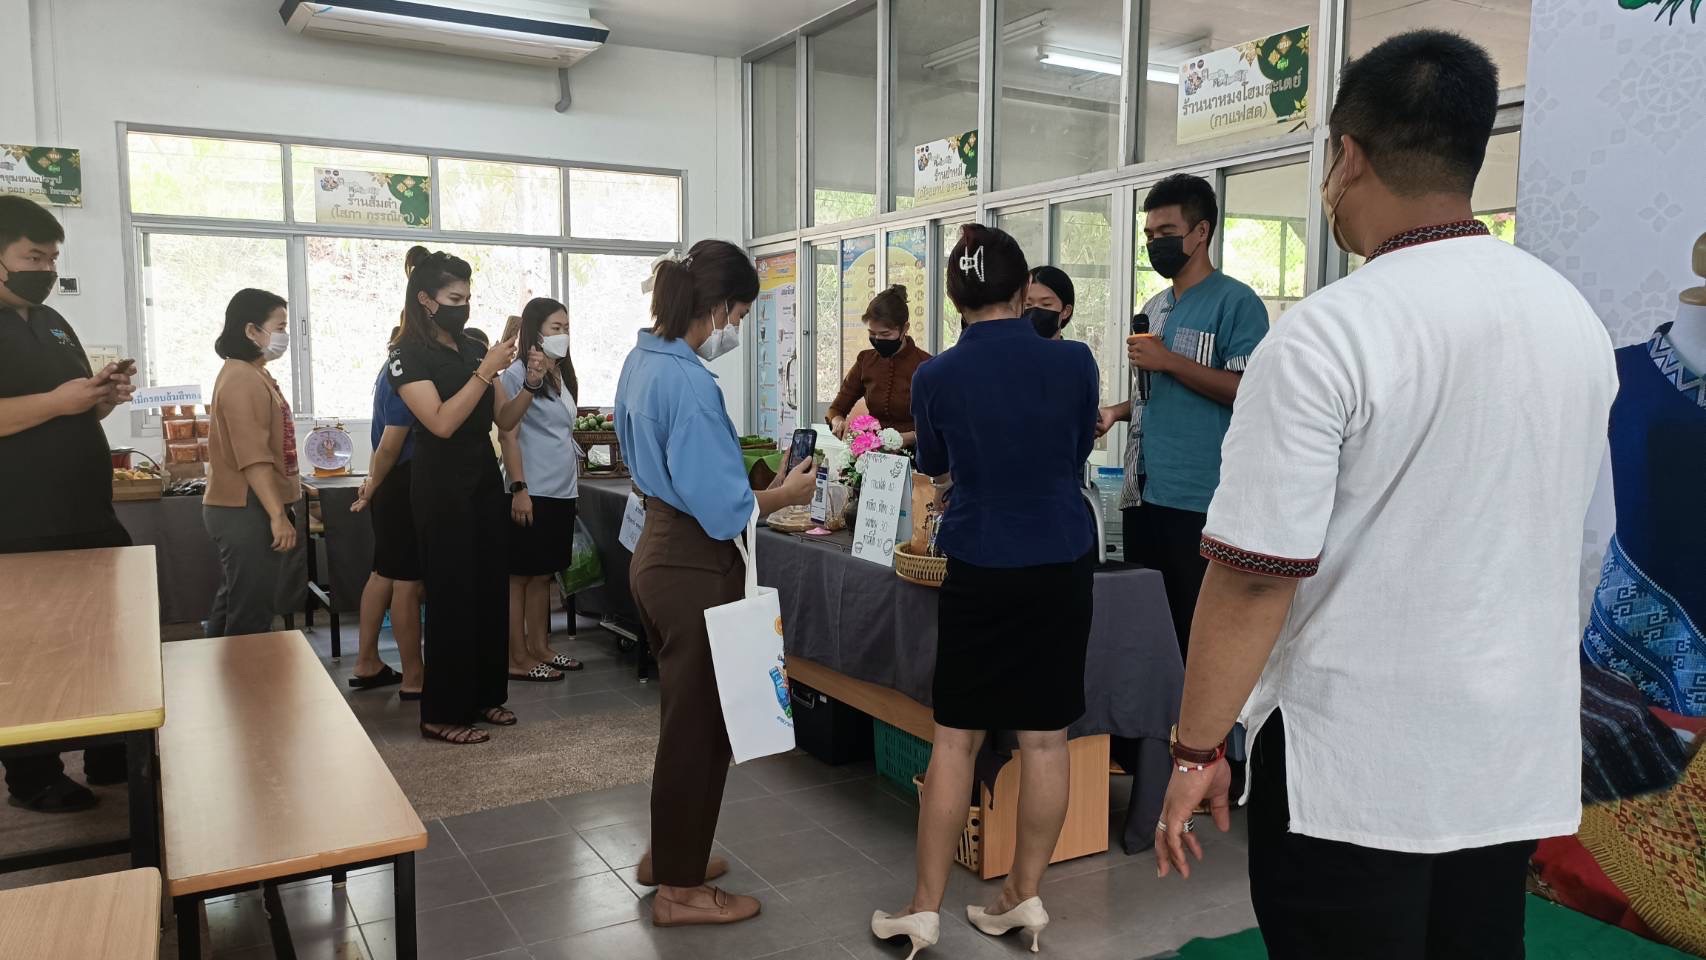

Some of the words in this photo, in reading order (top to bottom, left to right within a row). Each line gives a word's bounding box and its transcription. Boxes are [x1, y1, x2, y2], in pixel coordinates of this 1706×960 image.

[1210, 102, 1267, 130] (กาแฟสด)
[348, 193, 398, 209] ร้านส้มตำ
